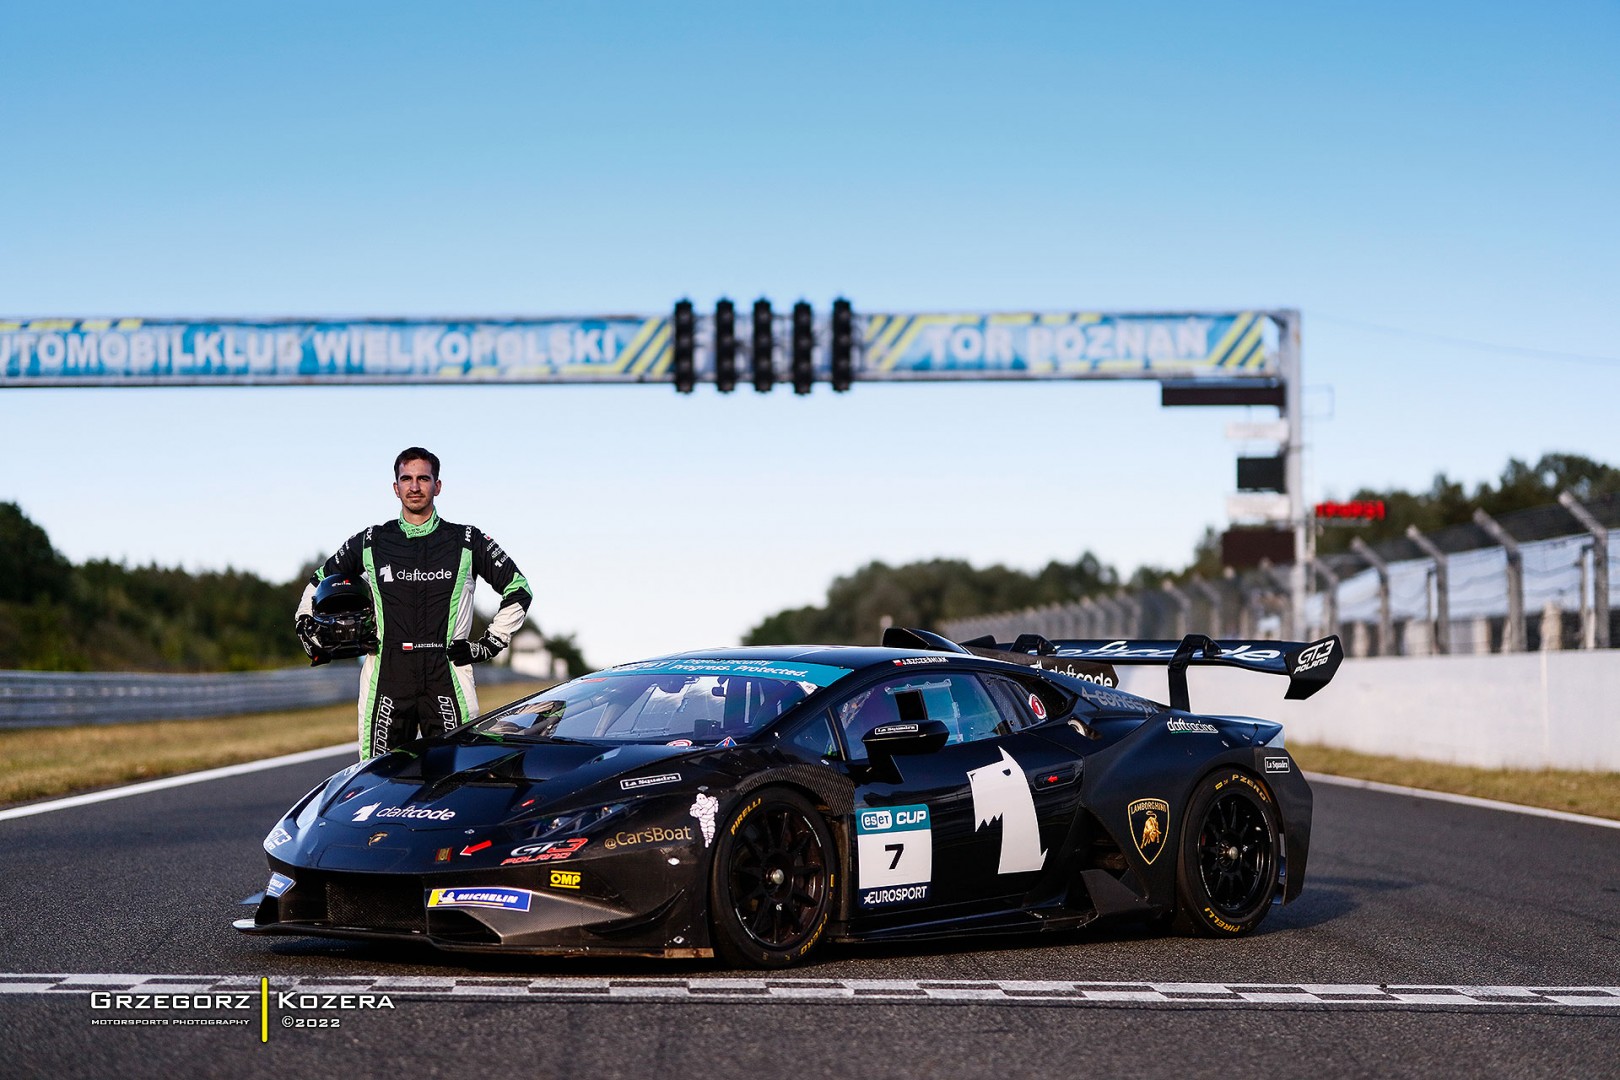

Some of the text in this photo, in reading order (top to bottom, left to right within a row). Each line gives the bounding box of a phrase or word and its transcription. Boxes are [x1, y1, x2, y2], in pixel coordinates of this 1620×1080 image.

[313, 328, 616, 367] WIELKOPOLSKI
[927, 325, 1014, 362] TOR
[396, 568, 452, 581] daftcode
[1298, 639, 1335, 665] GT3
[733, 665, 809, 678] Protected.
[1294, 656, 1329, 675] POLAND
[625, 775, 677, 788] La Squadra
[376, 804, 457, 821] daftcode
[730, 798, 762, 836] PIRELLI
[1130, 801, 1167, 815] LAMBORGHINI
[896, 811, 927, 825] CUP
[604, 826, 693, 849] @CarsBoat
[510, 837, 589, 857] GT3
[500, 851, 572, 866] POLAND
[884, 843, 905, 870] 7
[550, 873, 582, 886] OMP
[456, 893, 519, 904] MICHELIN
[864, 886, 928, 904] EUROSPORT
[1204, 907, 1241, 933] PIRELLI
